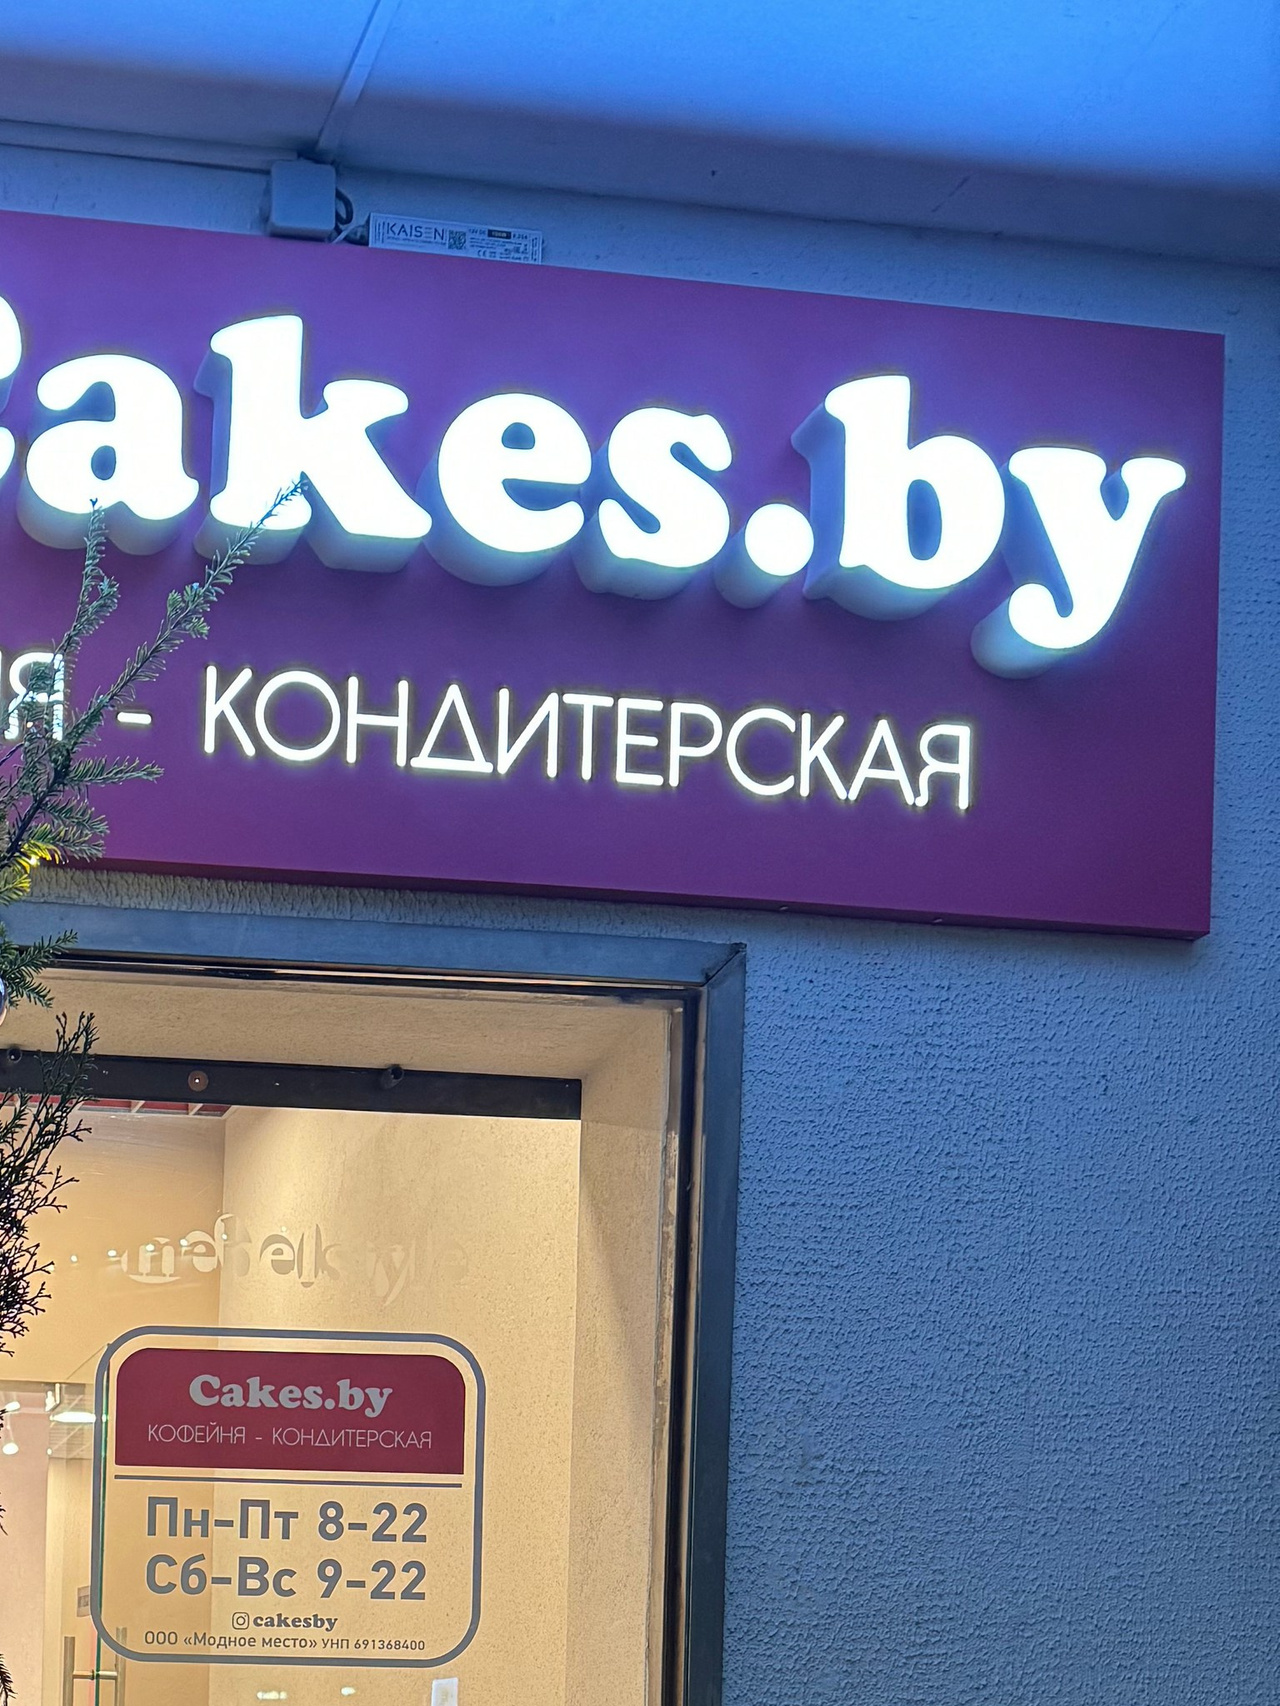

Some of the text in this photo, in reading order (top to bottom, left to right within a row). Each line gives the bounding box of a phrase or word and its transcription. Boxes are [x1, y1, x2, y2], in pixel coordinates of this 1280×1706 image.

[386, 221, 446, 241] KAISEN
[204, 664, 972, 810] КОНДИТЕРСКАЯ
[188, 1374, 394, 1418] Cakes.by
[147, 1422, 247, 1445] КОФЕЙНЯ
[272, 1427, 432, 1450] КОНДИТЕРСКАЯ
[146, 1496, 429, 1544] Пн-Пт 8-22
[145, 1553, 427, 1601] Сб-Вс 9-22
[252, 1612, 339, 1632] cakesby
[144, 1630, 426, 1651] ООО «Модное место» УНП 691368400
